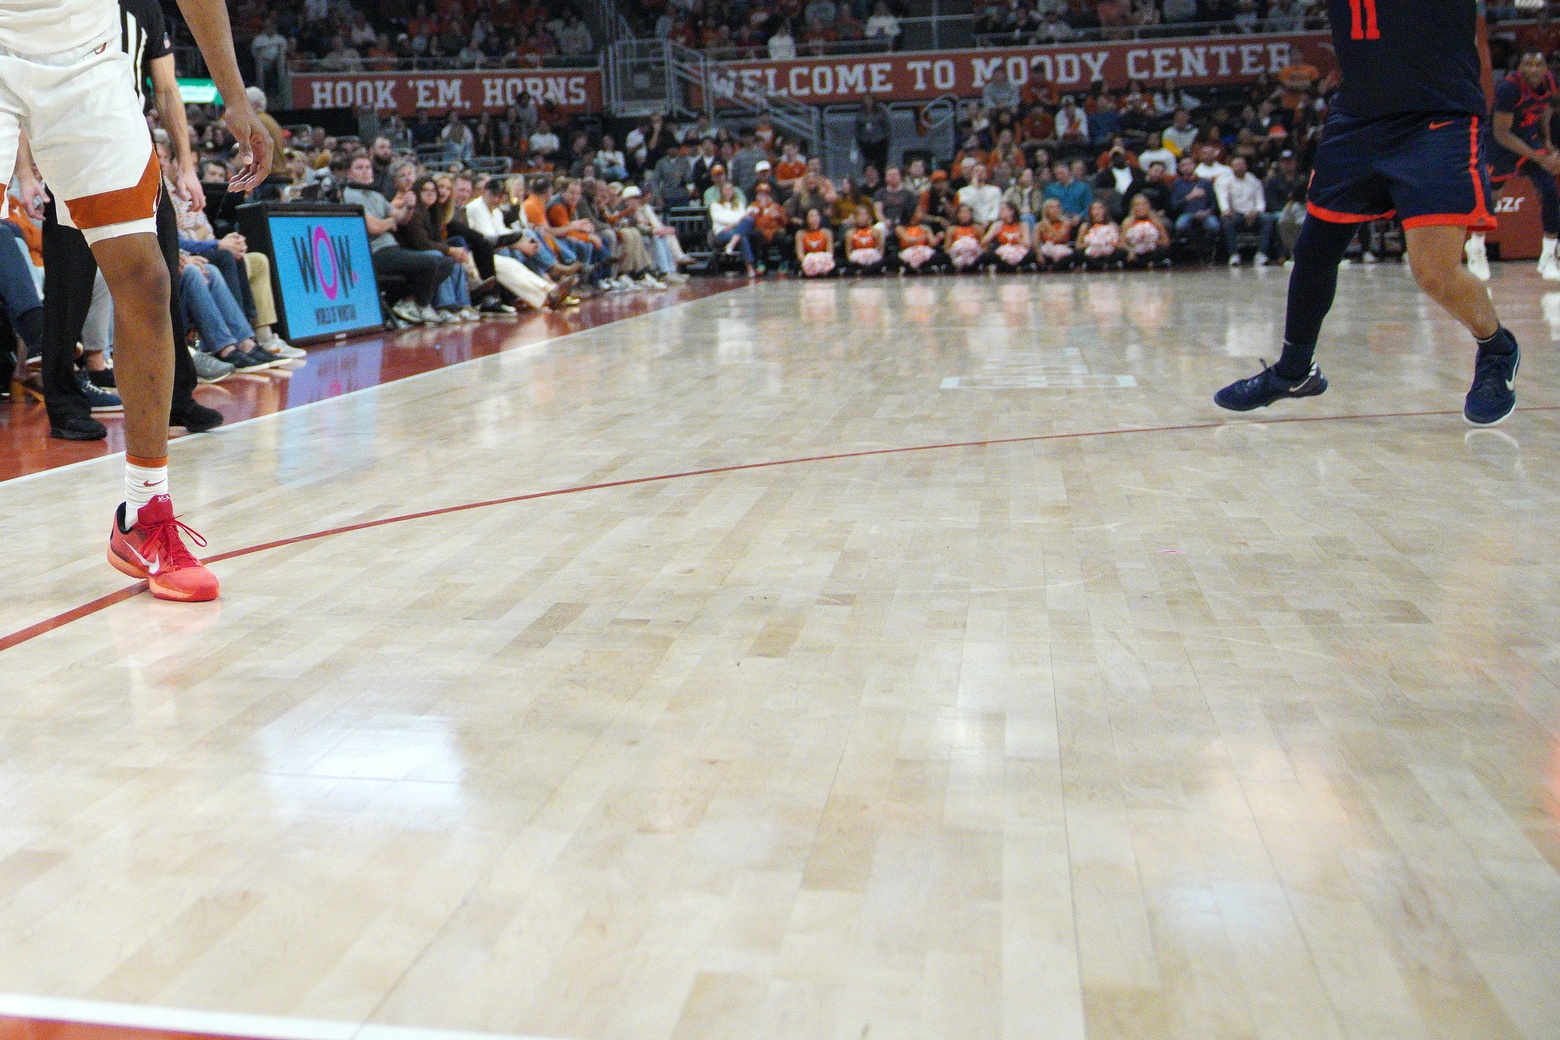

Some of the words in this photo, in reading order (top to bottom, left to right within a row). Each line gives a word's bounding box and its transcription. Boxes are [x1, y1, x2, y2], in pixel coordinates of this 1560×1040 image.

[310, 80, 397, 109] HOOK
[482, 76, 587, 107] HORNS
[710, 62, 893, 99] WELCOME
[907, 59, 956, 91] TO
[972, 51, 1110, 88] MOODY
[1125, 42, 1291, 80] CENTER
